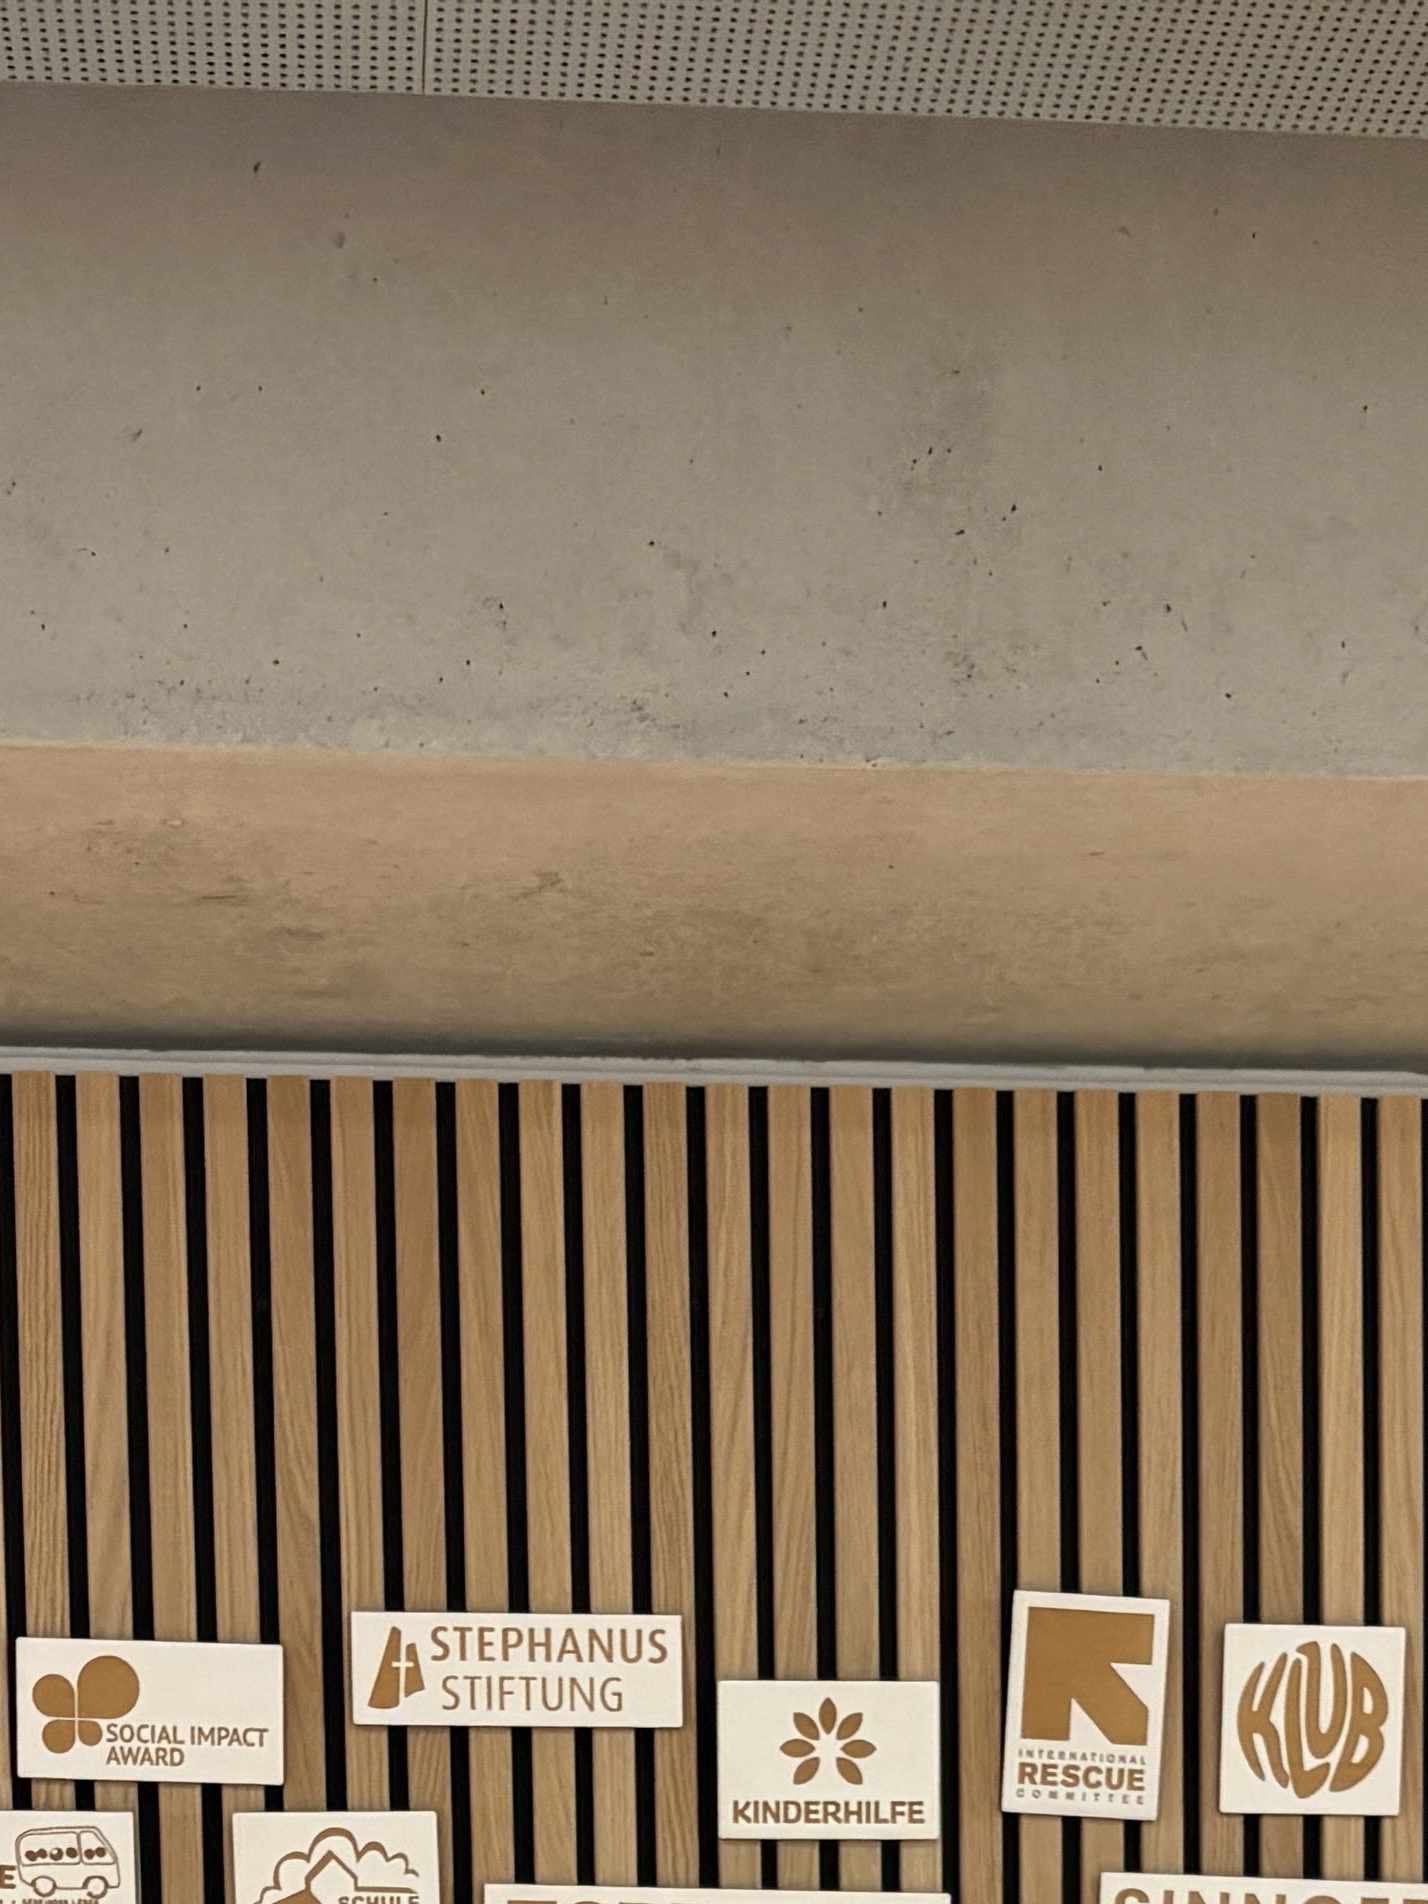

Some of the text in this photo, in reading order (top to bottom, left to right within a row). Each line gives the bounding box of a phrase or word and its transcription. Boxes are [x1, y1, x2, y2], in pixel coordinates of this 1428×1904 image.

[430, 1626, 668, 1664] STEPHANUS
[441, 1675, 623, 1712] STIFTUNG
[1237, 1640, 1389, 1799] KLUB
[105, 1723, 270, 1749] SOCIAL IMPACT
[105, 1746, 185, 1768] AWARD
[1017, 1748, 1147, 1766] INTERNATIONAL
[1017, 1761, 1146, 1792] RESCUE
[1015, 1787, 1145, 1806] COMMITTEE
[732, 1799, 926, 1825] KINDERHILFE
